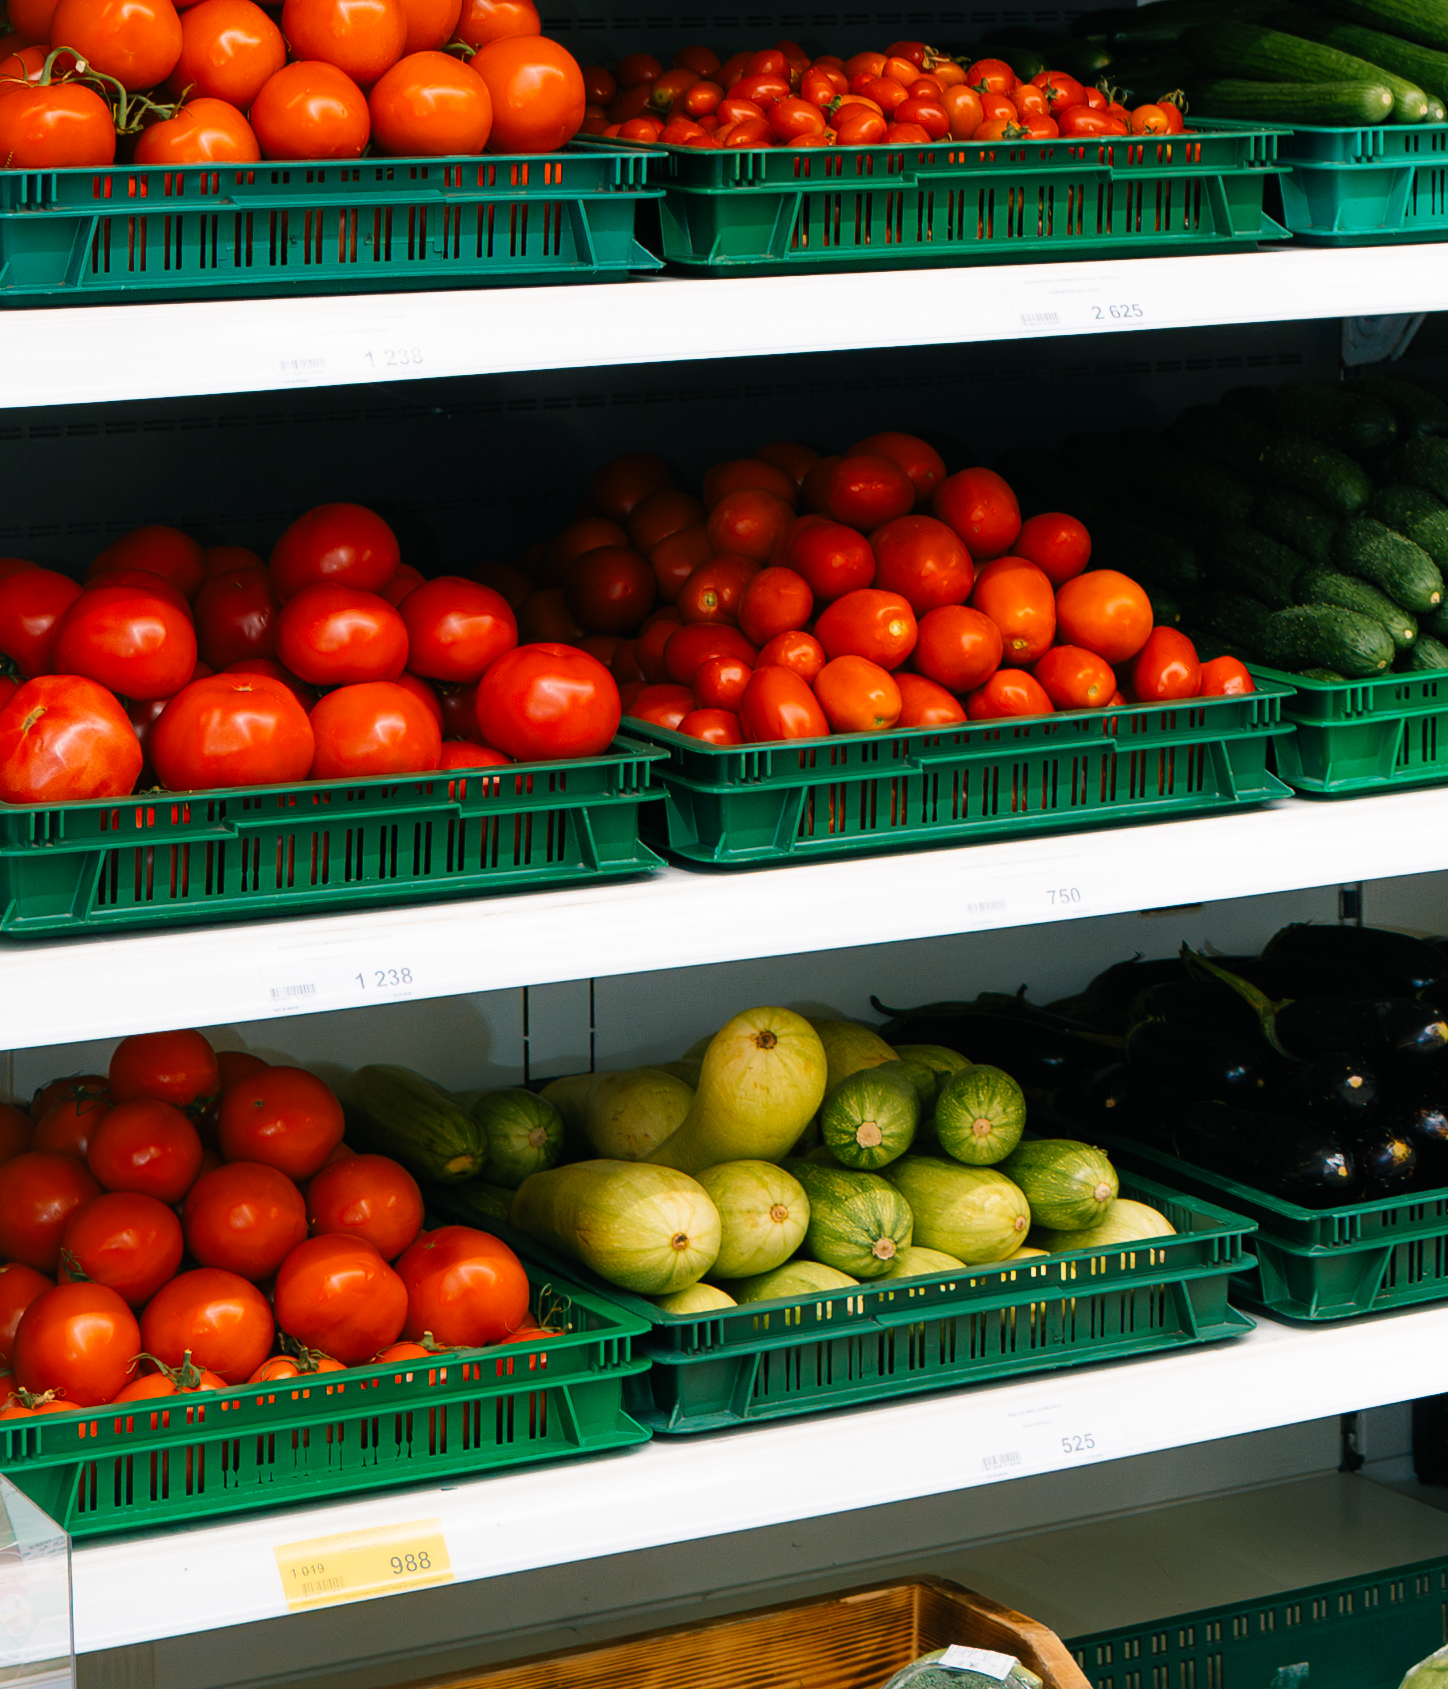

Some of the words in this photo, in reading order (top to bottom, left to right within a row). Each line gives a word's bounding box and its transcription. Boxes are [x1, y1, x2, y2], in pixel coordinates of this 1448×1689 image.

[1091, 305, 1105, 320] 2
[1110, 303, 1144, 319] 625
[365, 350, 375, 367] 1
[386, 347, 424, 366] 238
[1046, 887, 1081, 905] 750
[355, 972, 366, 990] 1
[374, 967, 414, 988] 238
[1061, 1433, 1096, 1454] 525
[301, 1563, 325, 1578] 019
[390, 1550, 432, 1575] 988
